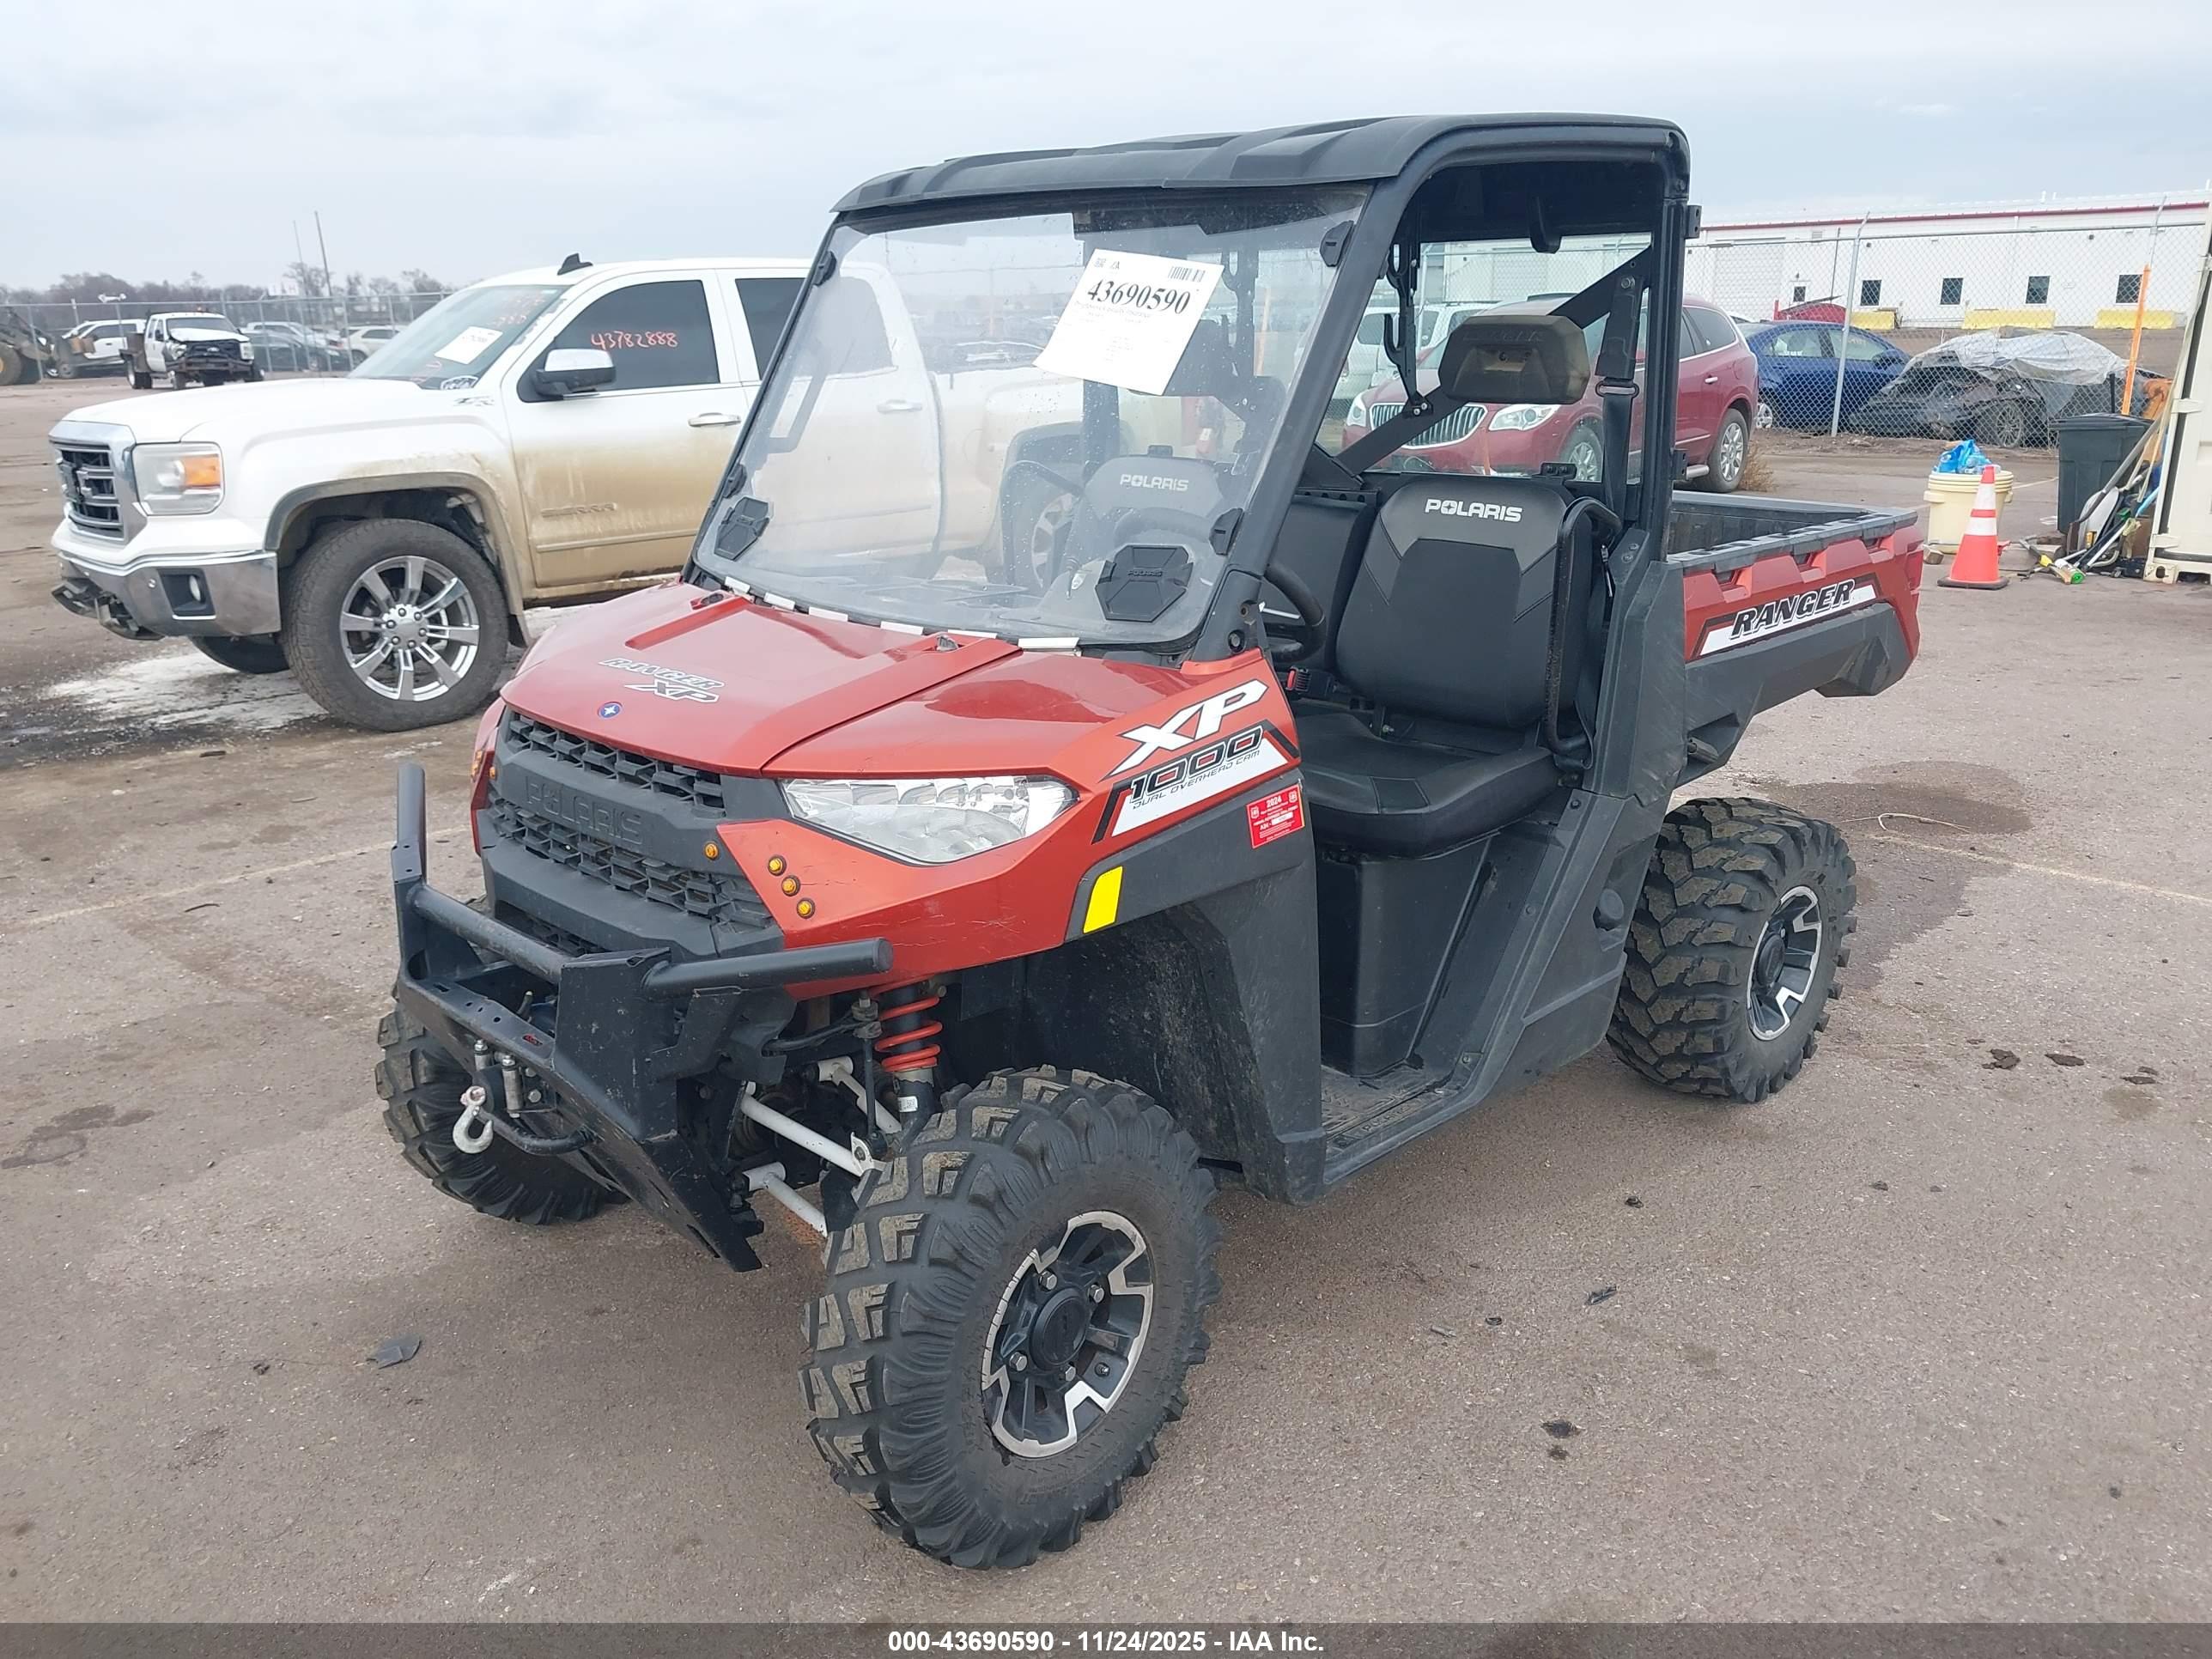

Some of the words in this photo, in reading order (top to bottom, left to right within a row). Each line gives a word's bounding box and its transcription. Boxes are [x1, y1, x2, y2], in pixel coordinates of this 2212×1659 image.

[1087, 279, 1191, 314] 43690590
[591, 331, 678, 349] 43782888
[1120, 474, 1189, 491] POLARIS
[1425, 498, 1523, 522] POLARIS
[1729, 578, 1855, 640] RANGER
[599, 658, 725, 689] RANGER
[623, 679, 720, 702] XP
[1100, 678, 1268, 781] XP
[1129, 725, 1263, 804] 1000
[1133, 792, 1166, 810] DUAL
[1170, 762, 1233, 793] OVERHEAD
[1236, 750, 1261, 765] CAM
[526, 775, 643, 845] POLARIS
[1267, 795, 1282, 808] 2024
